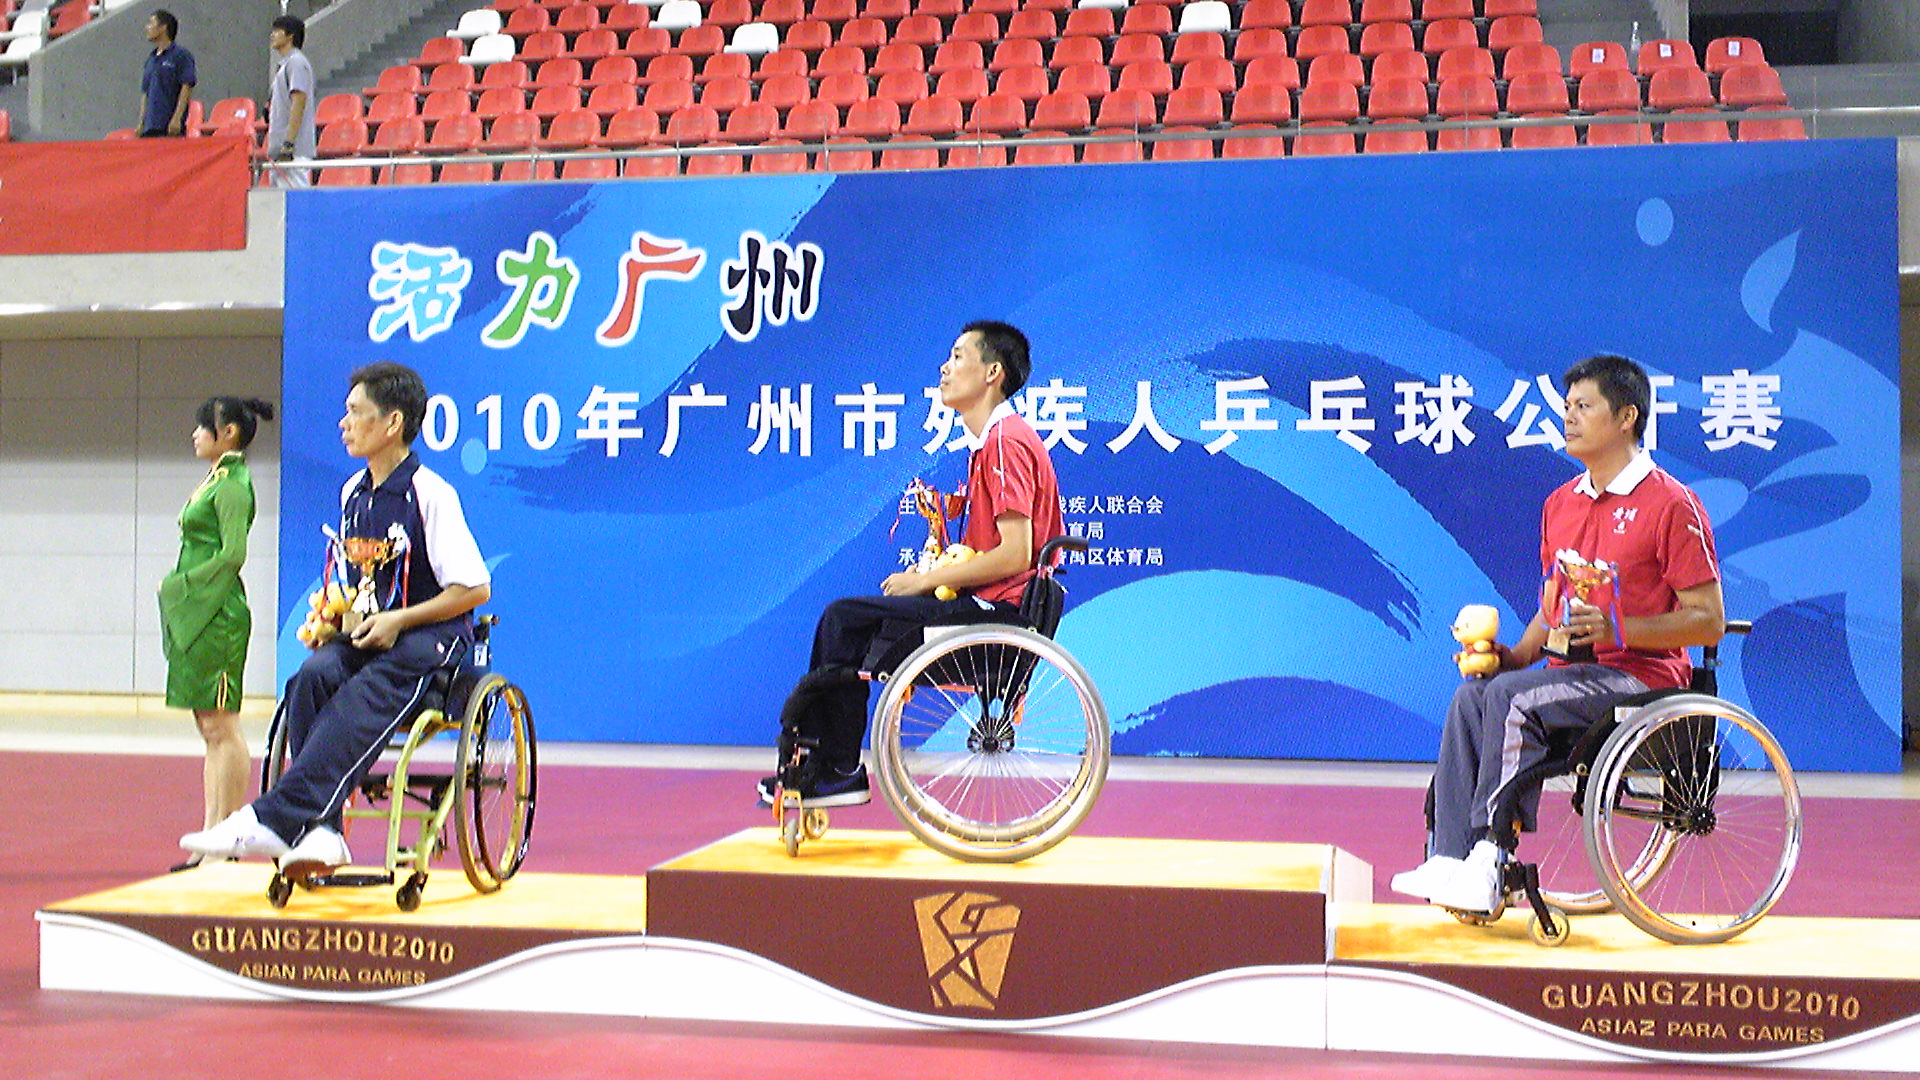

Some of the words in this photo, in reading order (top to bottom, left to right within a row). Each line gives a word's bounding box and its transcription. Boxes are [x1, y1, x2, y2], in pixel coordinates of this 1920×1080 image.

[368, 231, 824, 347] 活力广州
[239, 962, 296, 980] ASIAN
[303, 965, 351, 982] PARA
[358, 967, 426, 985] GAMES
[1541, 980, 1861, 1021] GUANGZHOU2010
[1667, 1020, 1728, 1039] PARA
[1738, 1024, 1825, 1042] GAMES
